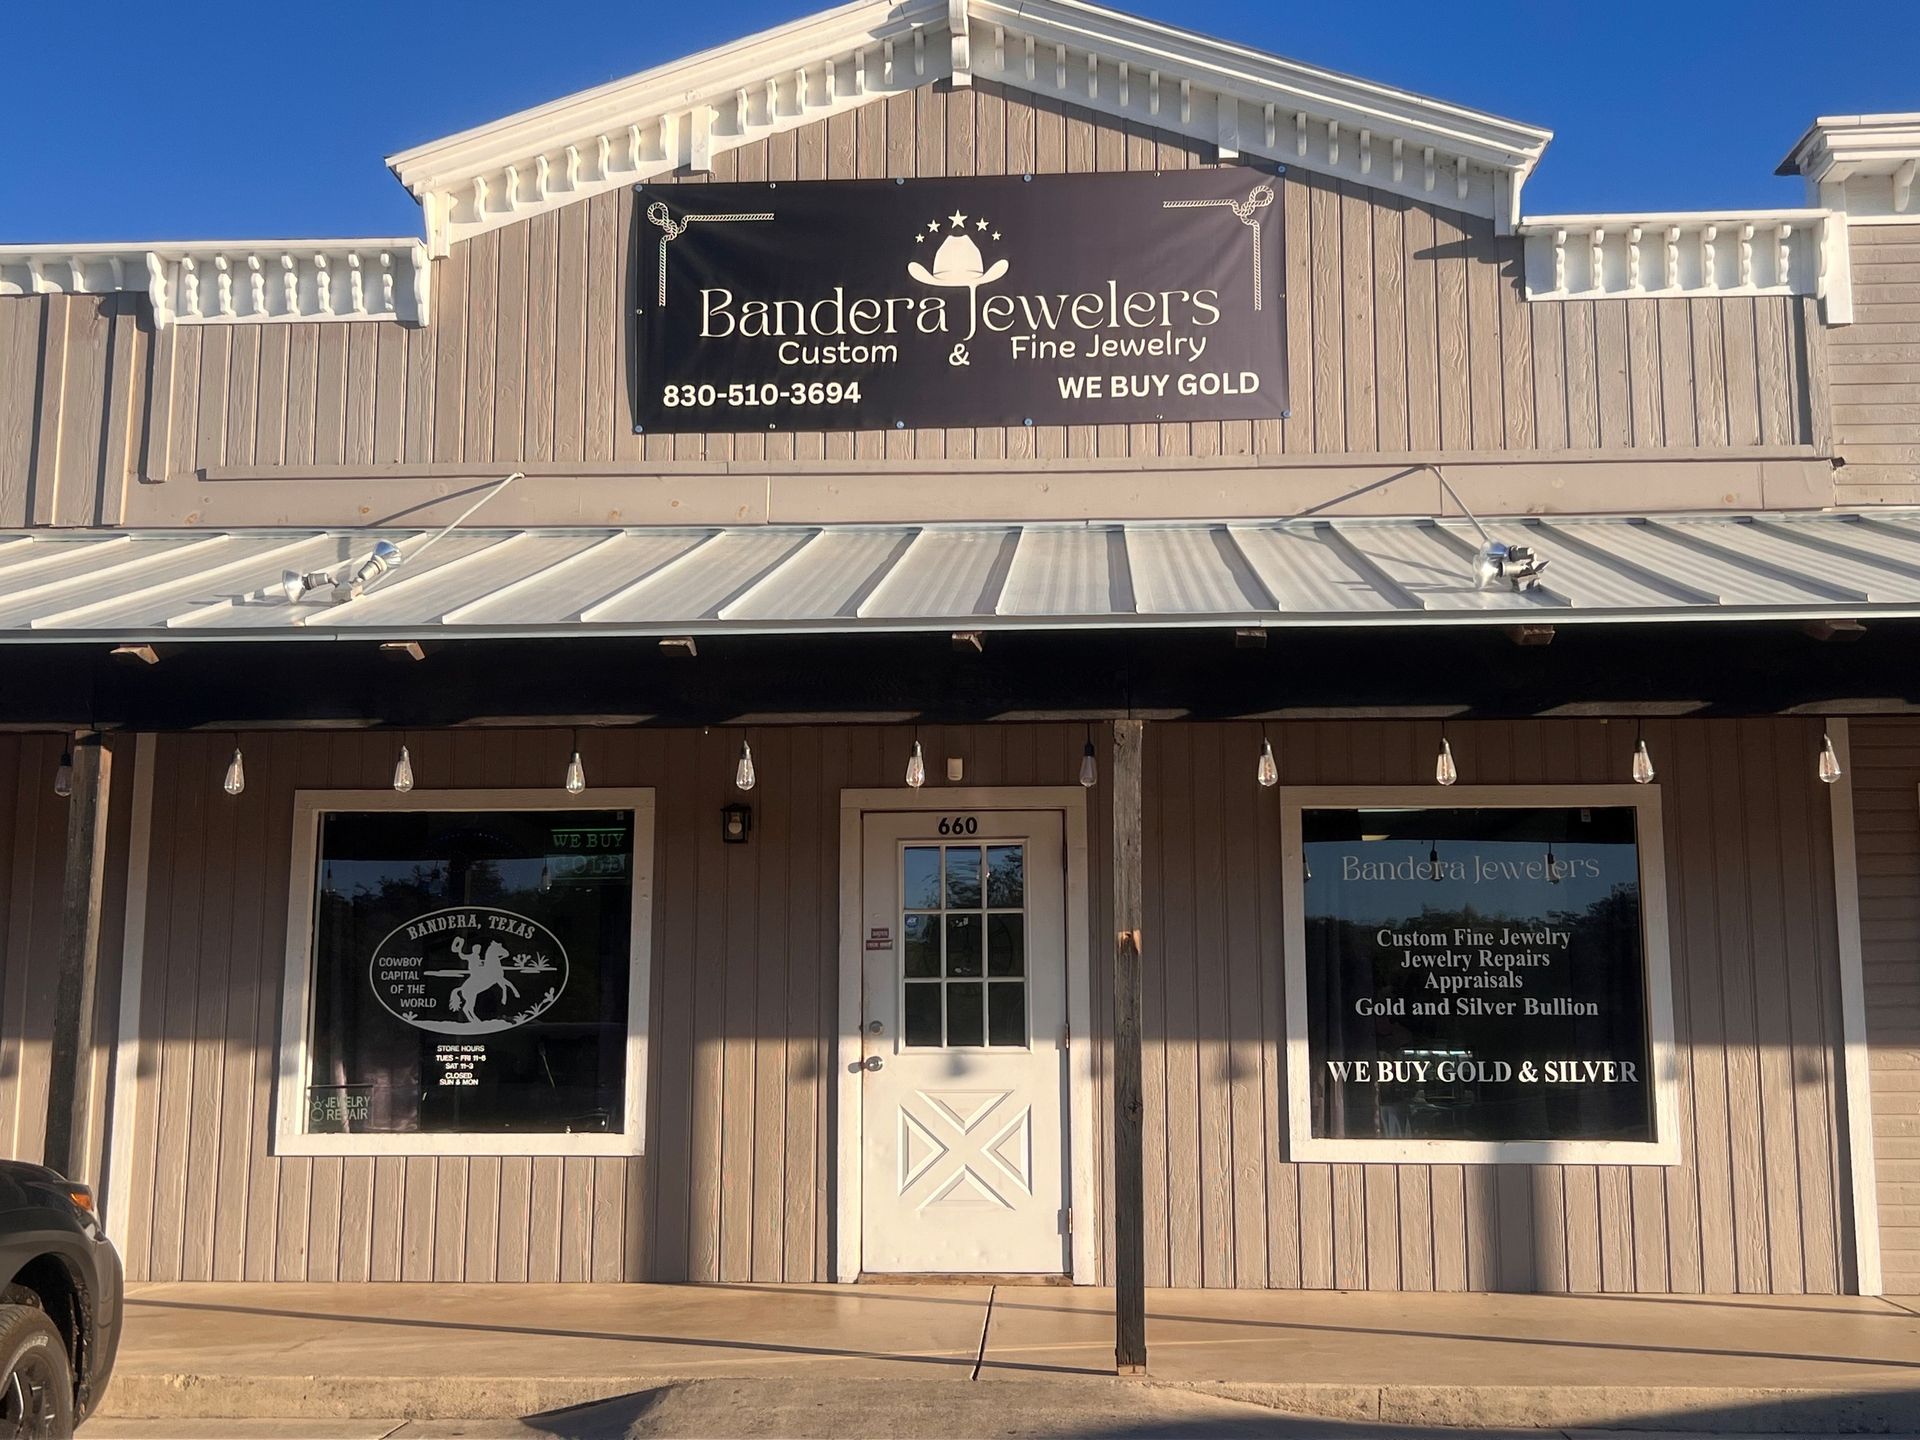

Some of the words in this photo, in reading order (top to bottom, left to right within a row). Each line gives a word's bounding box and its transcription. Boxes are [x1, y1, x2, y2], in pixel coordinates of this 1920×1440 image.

[699, 287, 949, 337] Bandera
[963, 279, 1221, 341] Jewelers
[778, 341, 898, 365] Custom
[948, 343, 971, 366] &
[1011, 334, 1076, 360] Fine
[1085, 330, 1207, 362] Jewelry
[663, 381, 861, 407] 830-510-3694
[1057, 376, 1103, 399] WE
[1110, 374, 1170, 398] BUY
[1177, 371, 1260, 396] GOLD
[938, 817, 978, 835] 660
[553, 834, 581, 848] WE
[586, 833, 624, 848] BUY
[1342, 855, 1466, 882] Bandera
[1473, 855, 1600, 884] Jewelers
[406, 914, 482, 941] BANDERA,
[488, 915, 536, 940] TEXAS
[1376, 929, 1448, 948] Custom
[1453, 928, 1494, 946] Fine
[1499, 928, 1571, 950] Jewelry
[378, 957, 424, 967] COWBOY
[1400, 949, 1472, 972] Jewelry
[1478, 949, 1550, 971] Repairs
[380, 970, 420, 981] CAPITAL
[1424, 970, 1523, 994] Appraisals
[390, 984, 404, 995] OF
[407, 984, 426, 994] THE
[400, 997, 437, 1009] WORLD
[1355, 998, 1406, 1017] Gold
[1412, 998, 1450, 1016] and
[1456, 998, 1518, 1016] Silver
[1523, 998, 1599, 1016] Bullion
[1326, 1060, 1371, 1083] WE
[1376, 1060, 1430, 1083] BUY
[1437, 1060, 1512, 1083] GOLD
[1518, 1060, 1539, 1083] &
[1544, 1060, 1639, 1083] SILVER
[326, 1108, 369, 1121] REAIR
